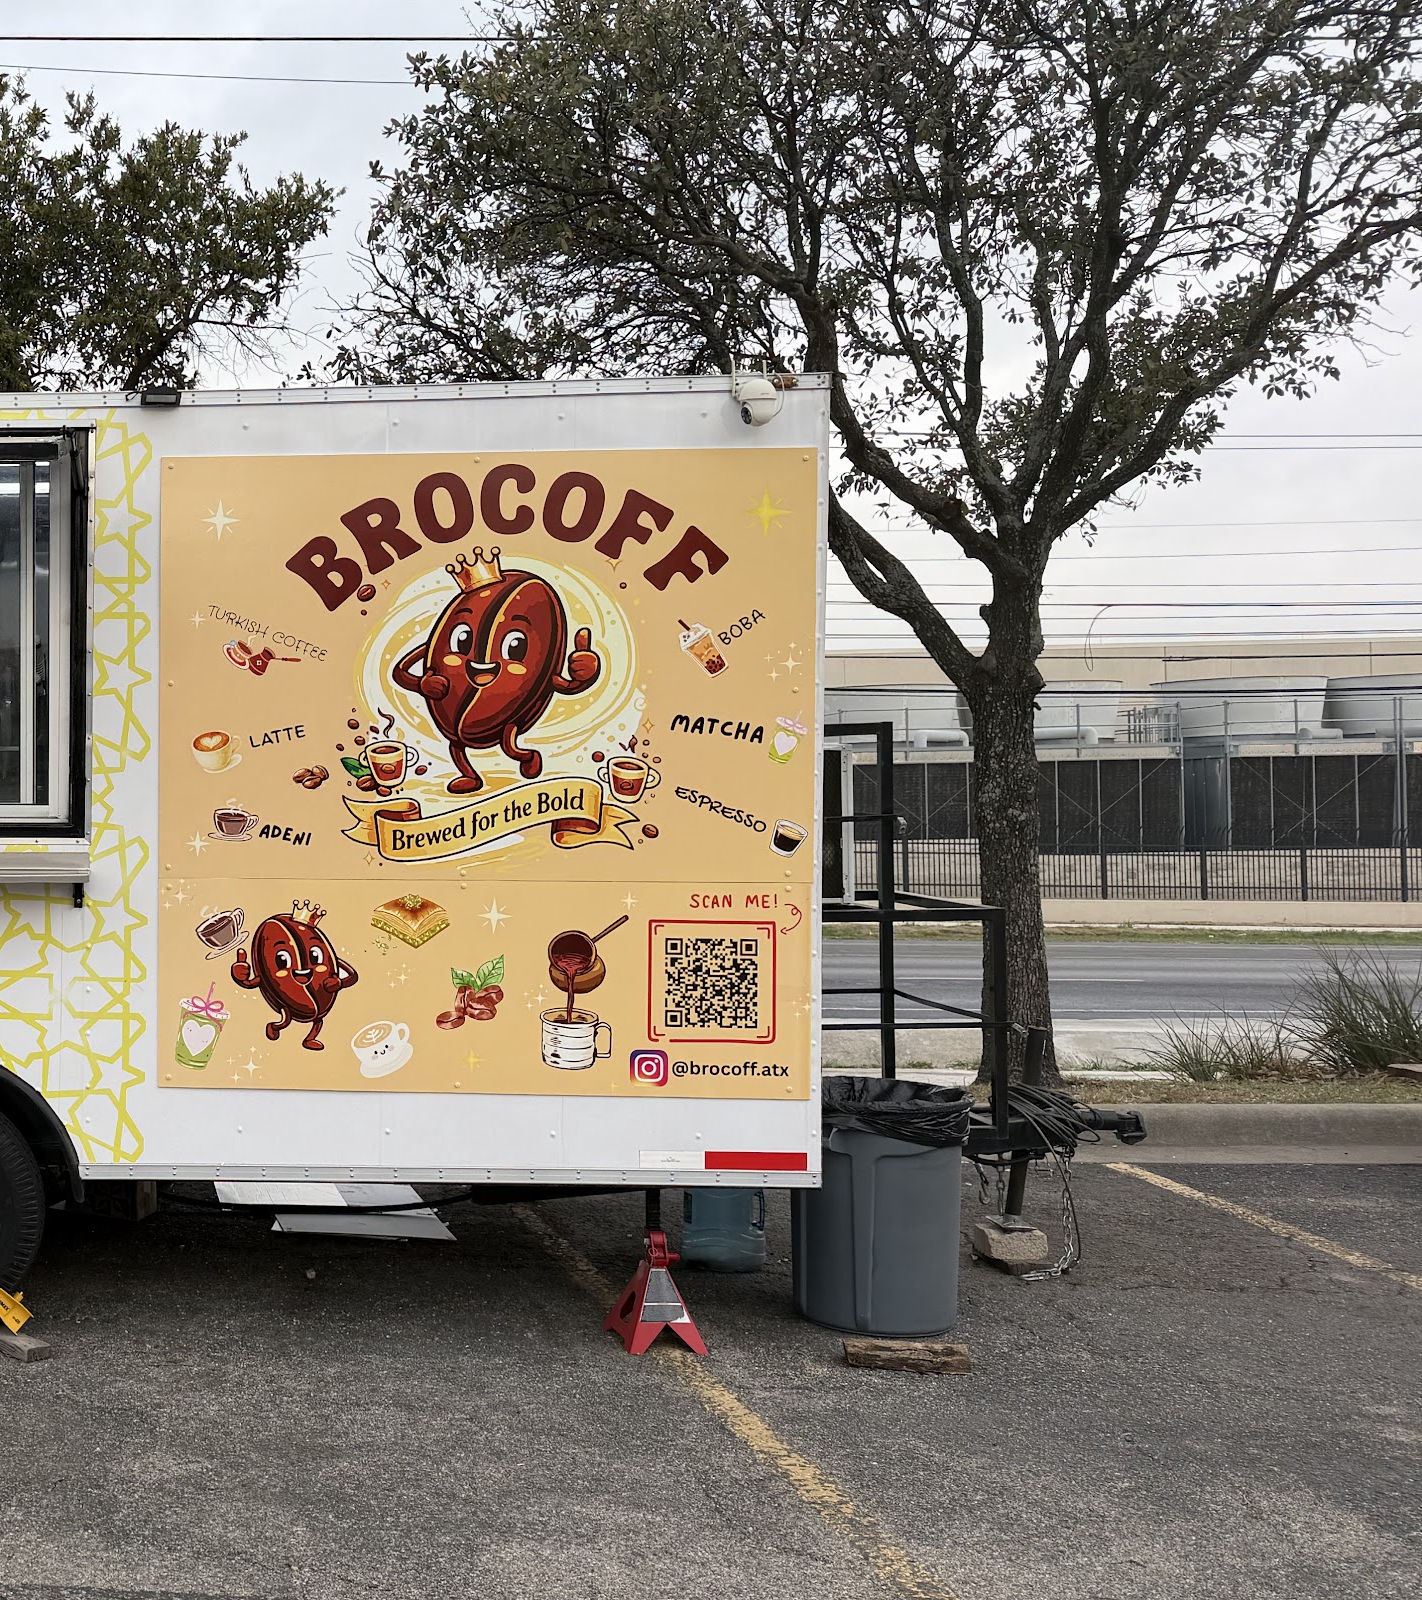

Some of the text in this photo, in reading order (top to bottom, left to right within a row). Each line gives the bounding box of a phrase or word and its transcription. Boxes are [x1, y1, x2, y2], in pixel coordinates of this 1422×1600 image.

[285, 464, 729, 612] BROCOFF
[208, 605, 328, 662] TURKISH COFFEE
[717, 609, 766, 645] BOBA
[249, 725, 306, 748] LATTE
[671, 714, 764, 744] MATCHA
[392, 788, 584, 850] Brewed for the Bold
[675, 786, 767, 833] ESPRESSO
[259, 824, 312, 846] ADENI
[690, 894, 778, 909] SCAN ME!
[672, 1061, 789, 1077] @brocoff.atx
